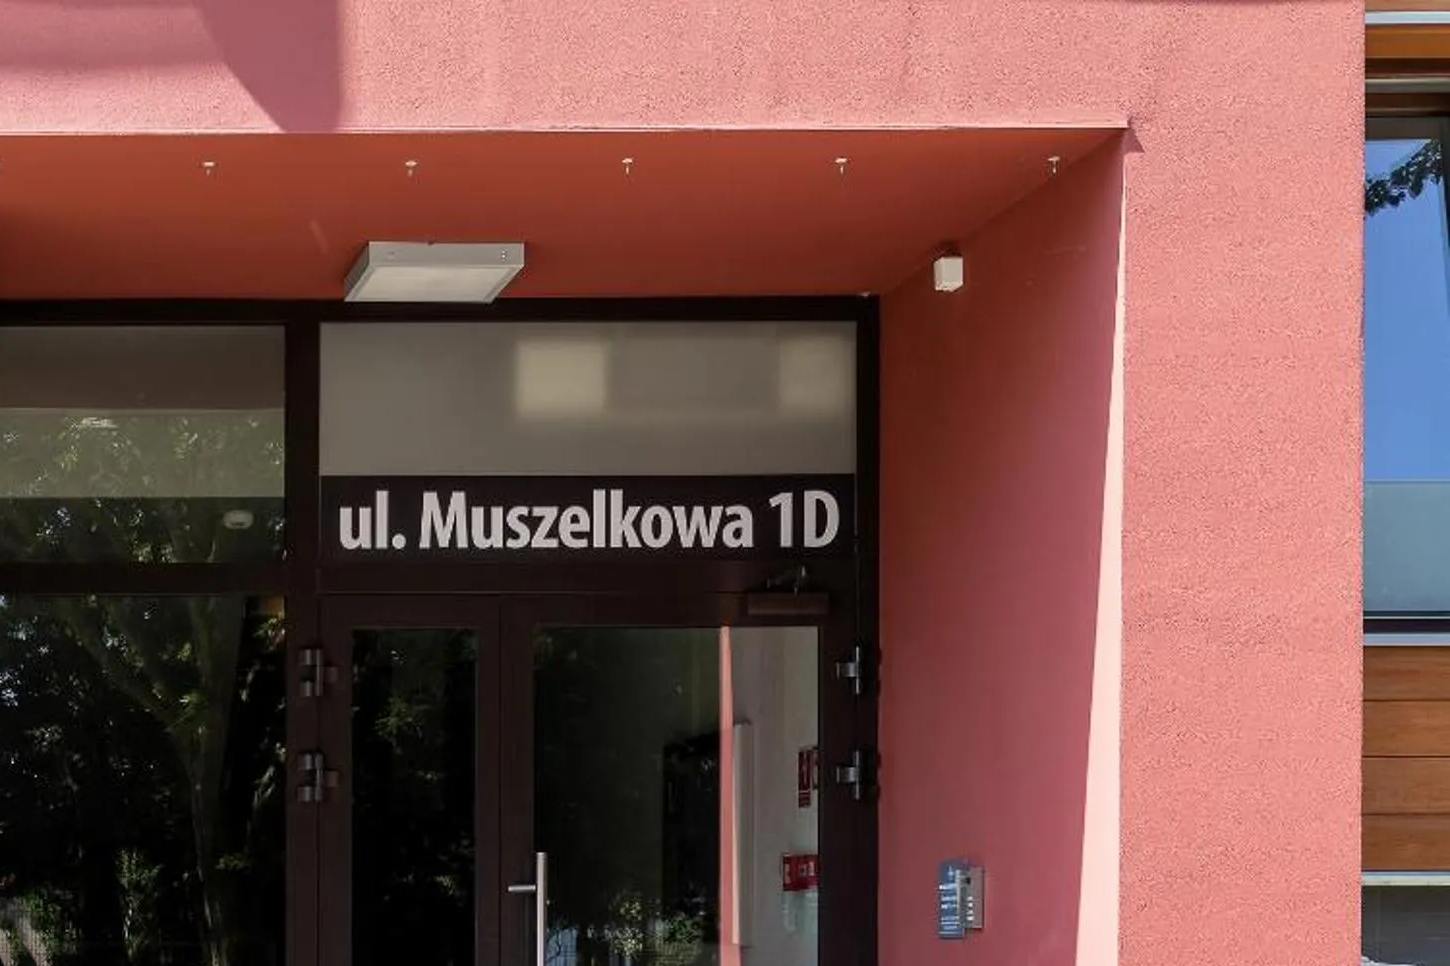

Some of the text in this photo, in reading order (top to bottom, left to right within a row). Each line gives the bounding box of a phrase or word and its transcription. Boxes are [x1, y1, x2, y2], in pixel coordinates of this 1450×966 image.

[339, 489, 840, 549] ul. Muszelkowa 1D
